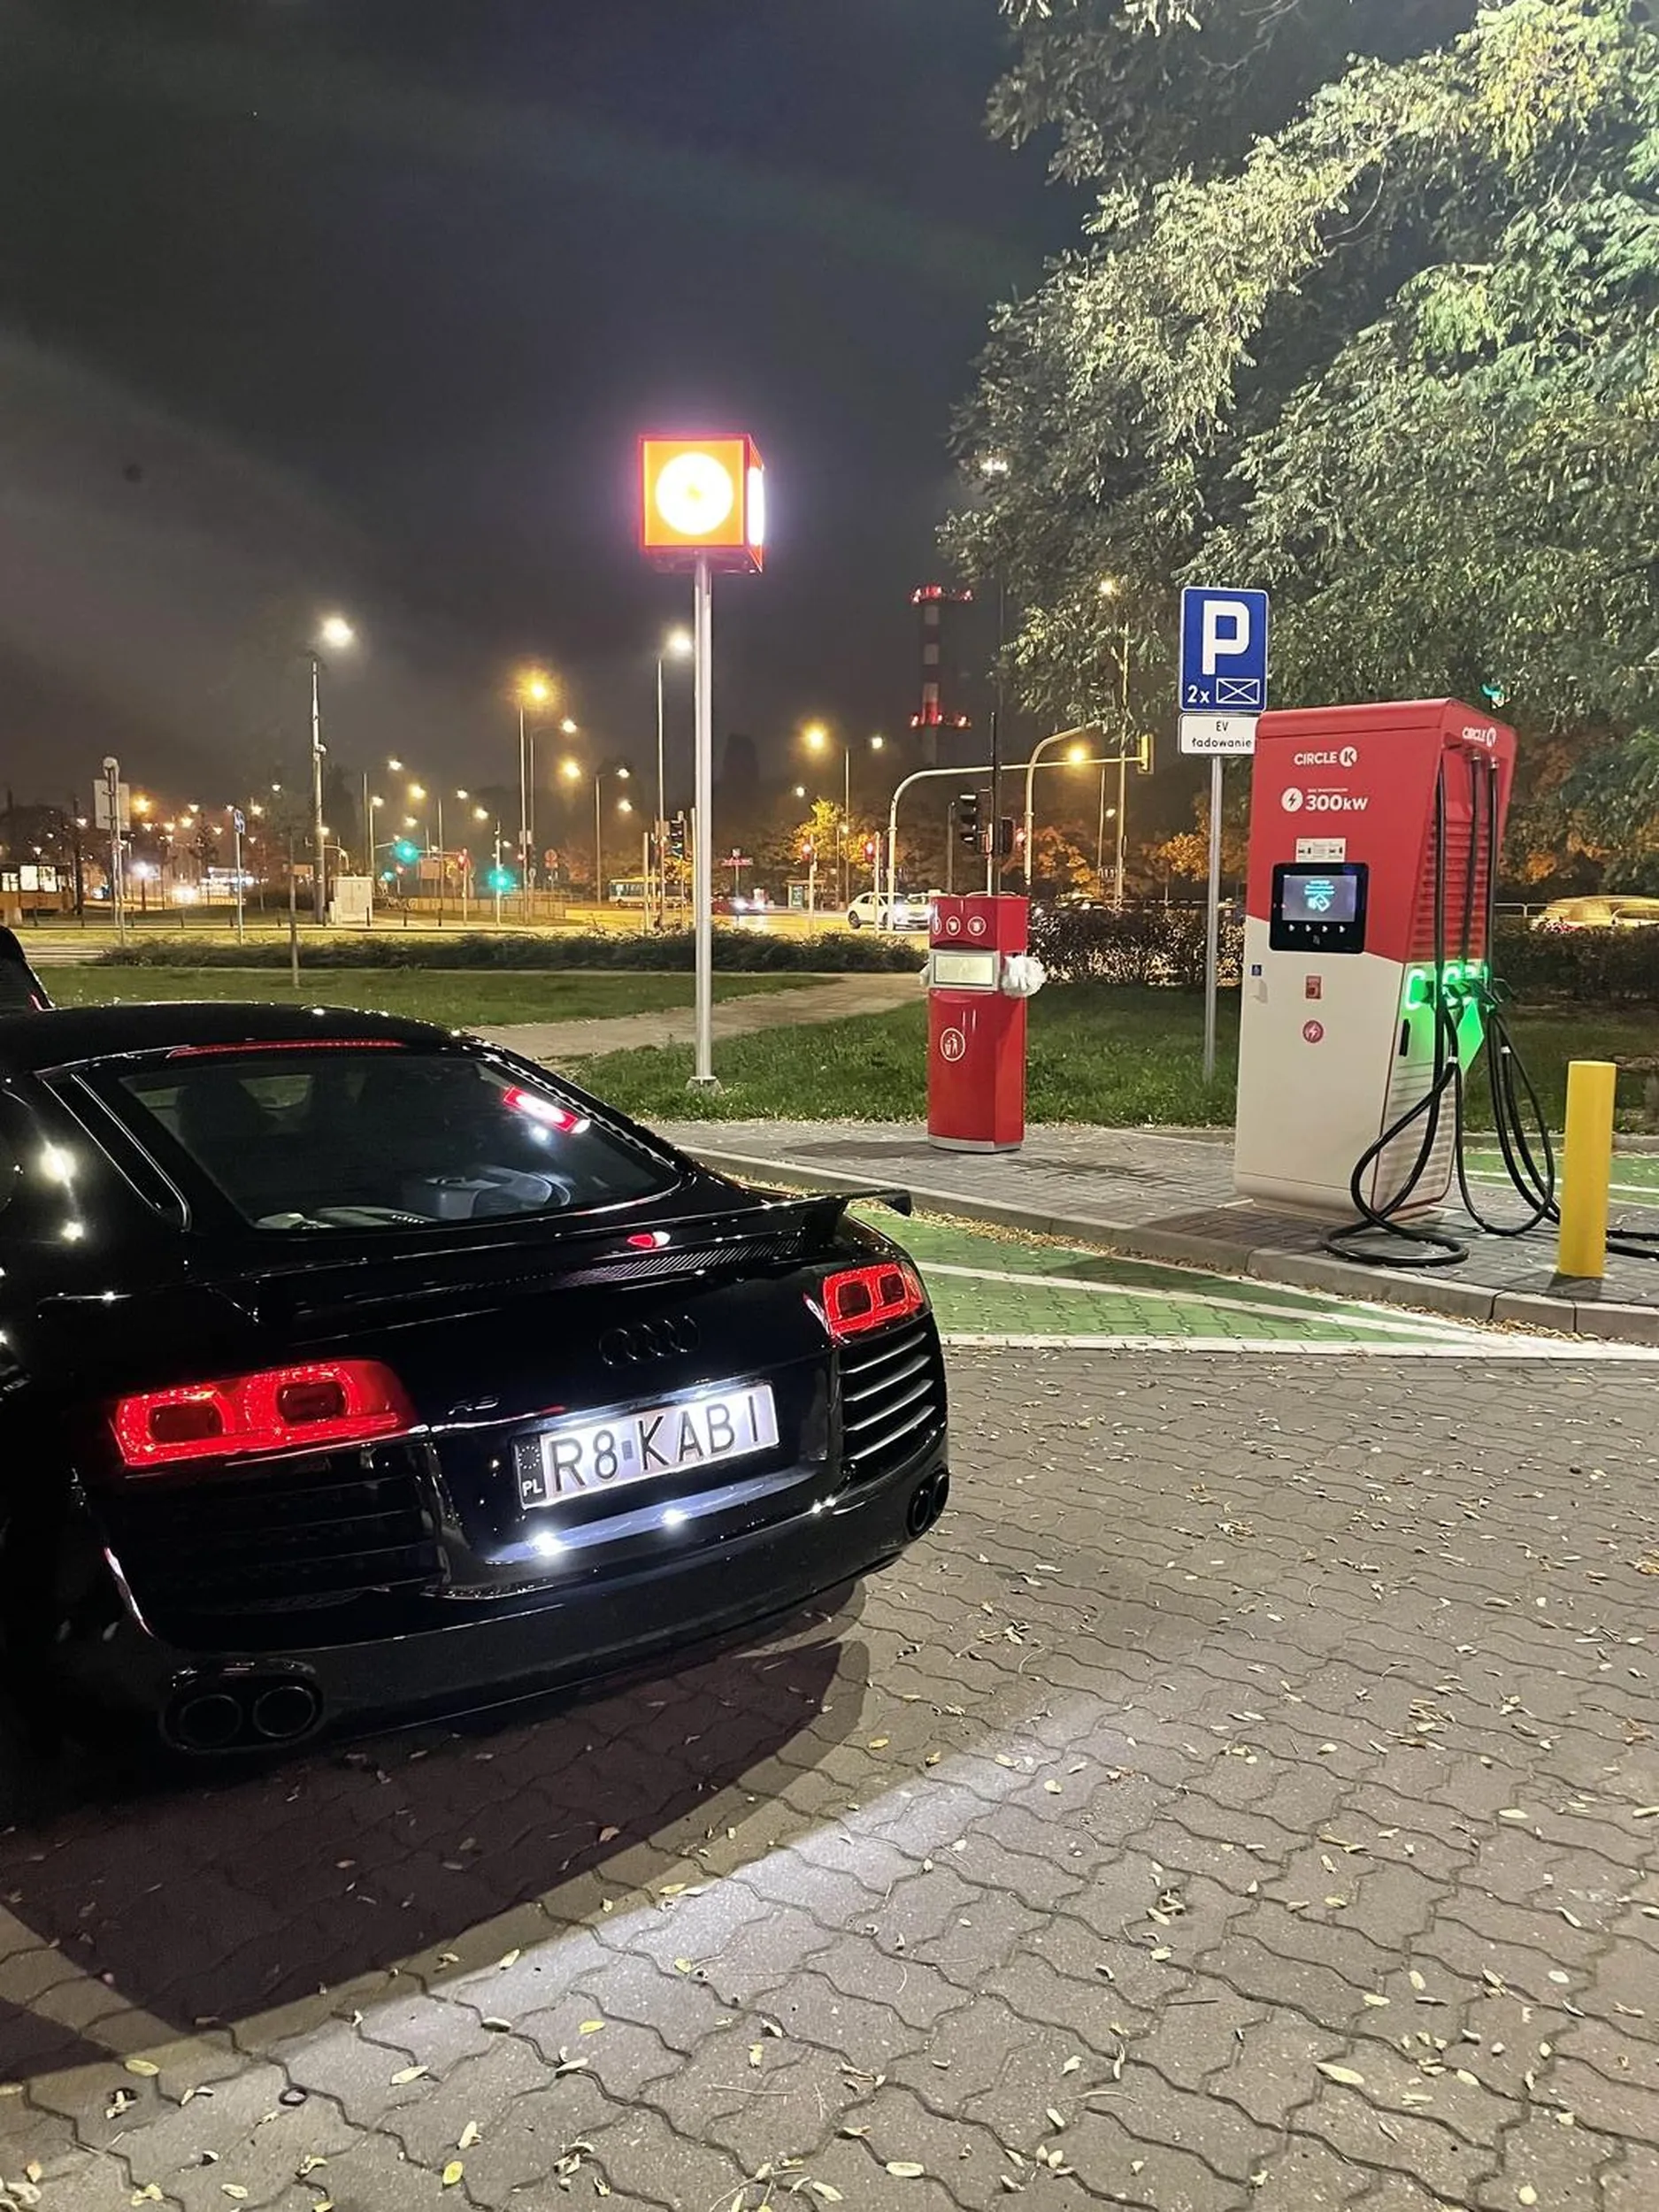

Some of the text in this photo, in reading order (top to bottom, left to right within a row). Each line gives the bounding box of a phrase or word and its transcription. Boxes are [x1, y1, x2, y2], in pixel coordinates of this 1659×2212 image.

[1202, 600, 1249, 675] P
[1187, 685, 1210, 703] 2x
[1216, 720, 1229, 733] EV
[1462, 726, 1486, 742] CIRCLE
[1294, 746, 1357, 767] CIRCLE K
[1305, 794, 1368, 811] 300kW
[549, 1394, 759, 1493] R8 KABI
[522, 1480, 543, 1497] PL
